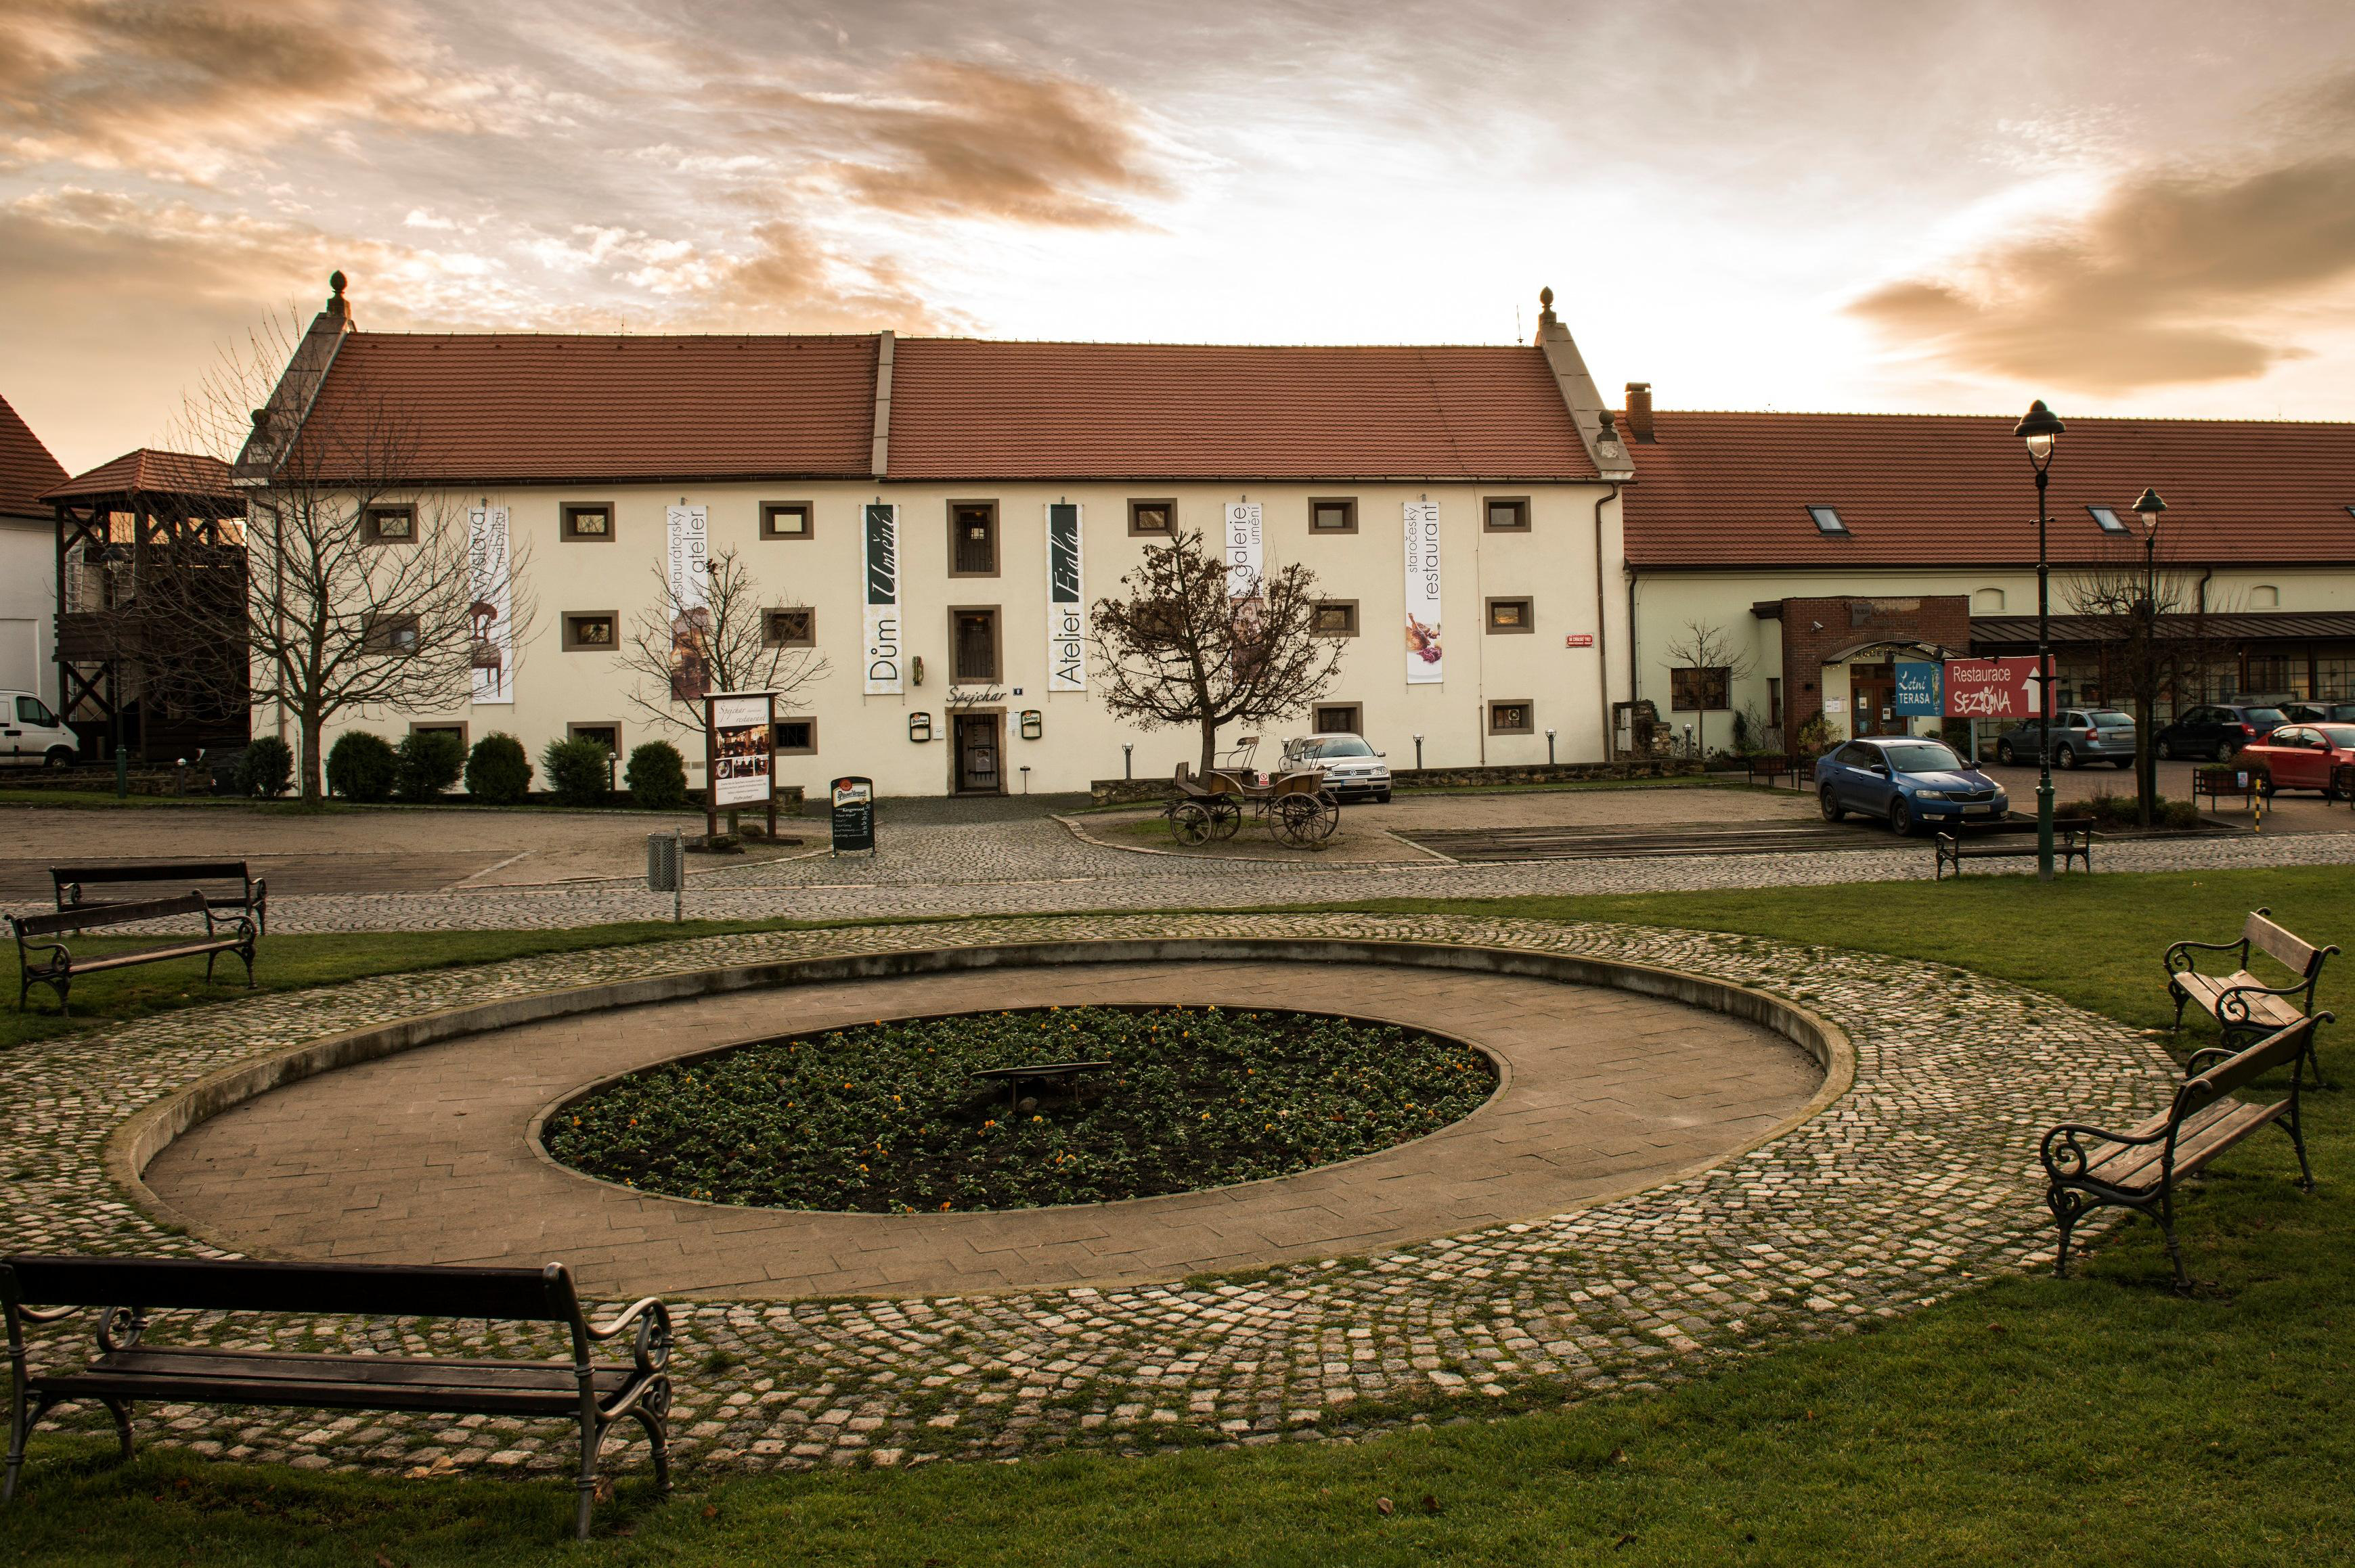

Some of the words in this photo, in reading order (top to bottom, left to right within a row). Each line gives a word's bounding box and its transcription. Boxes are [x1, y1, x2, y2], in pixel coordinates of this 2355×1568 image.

[682, 511, 705, 573] atelier
[871, 512, 895, 596] Umění
[1226, 507, 1254, 577] galerie
[1248, 506, 1260, 544] umění
[1404, 507, 1421, 573] staročeský
[1422, 505, 1438, 600] restaurant
[1051, 527, 1078, 596] Fiala
[870, 620, 898, 680] Dům
[1053, 608, 1081, 684] Atelier
[1953, 666, 2010, 683] Restaurace
[946, 684, 1007, 710] Špejchar
[1899, 671, 1927, 690] Letní
[1899, 693, 1930, 704] TERASA
[736, 715, 766, 723] restaurant
